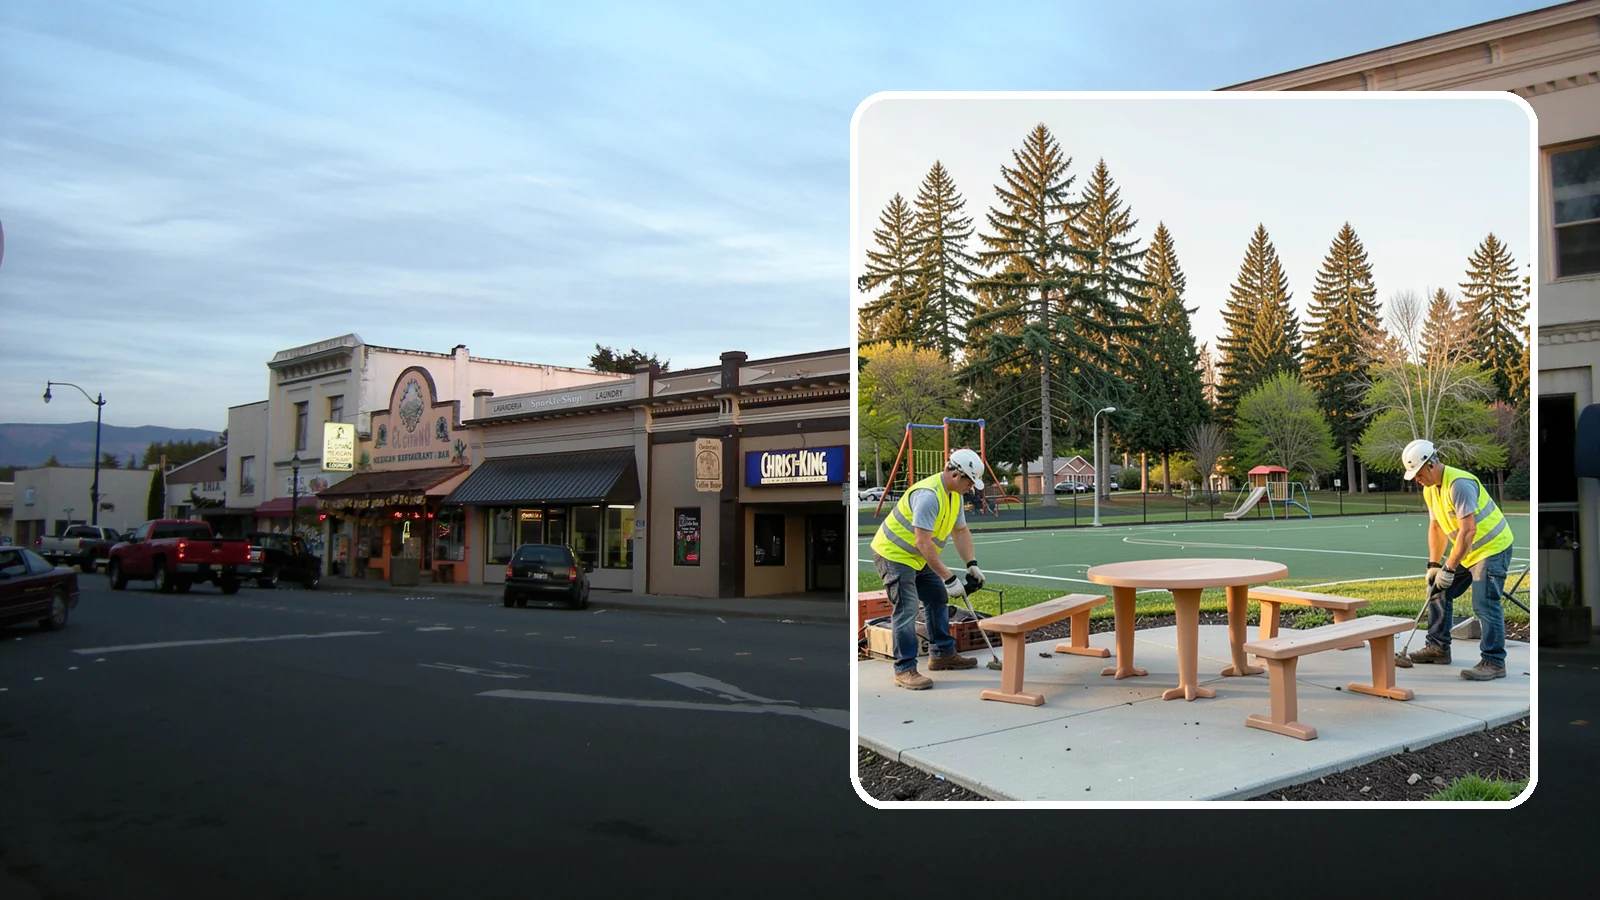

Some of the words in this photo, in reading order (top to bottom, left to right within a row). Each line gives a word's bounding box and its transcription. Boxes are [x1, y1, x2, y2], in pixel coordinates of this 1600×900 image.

[530, 397, 561, 409] Sparkle
[562, 394, 583, 404] Shop
[595, 389, 623, 400] LAUNDRY
[493, 402, 523, 413] LAVANDERIA
[373, 455, 396, 464] MEXICAN
[397, 452, 433, 462] RESTAURANT
[437, 450, 450, 460] BAR
[761, 452, 797, 478] CHRIST
[799, 450, 827, 476] KING
